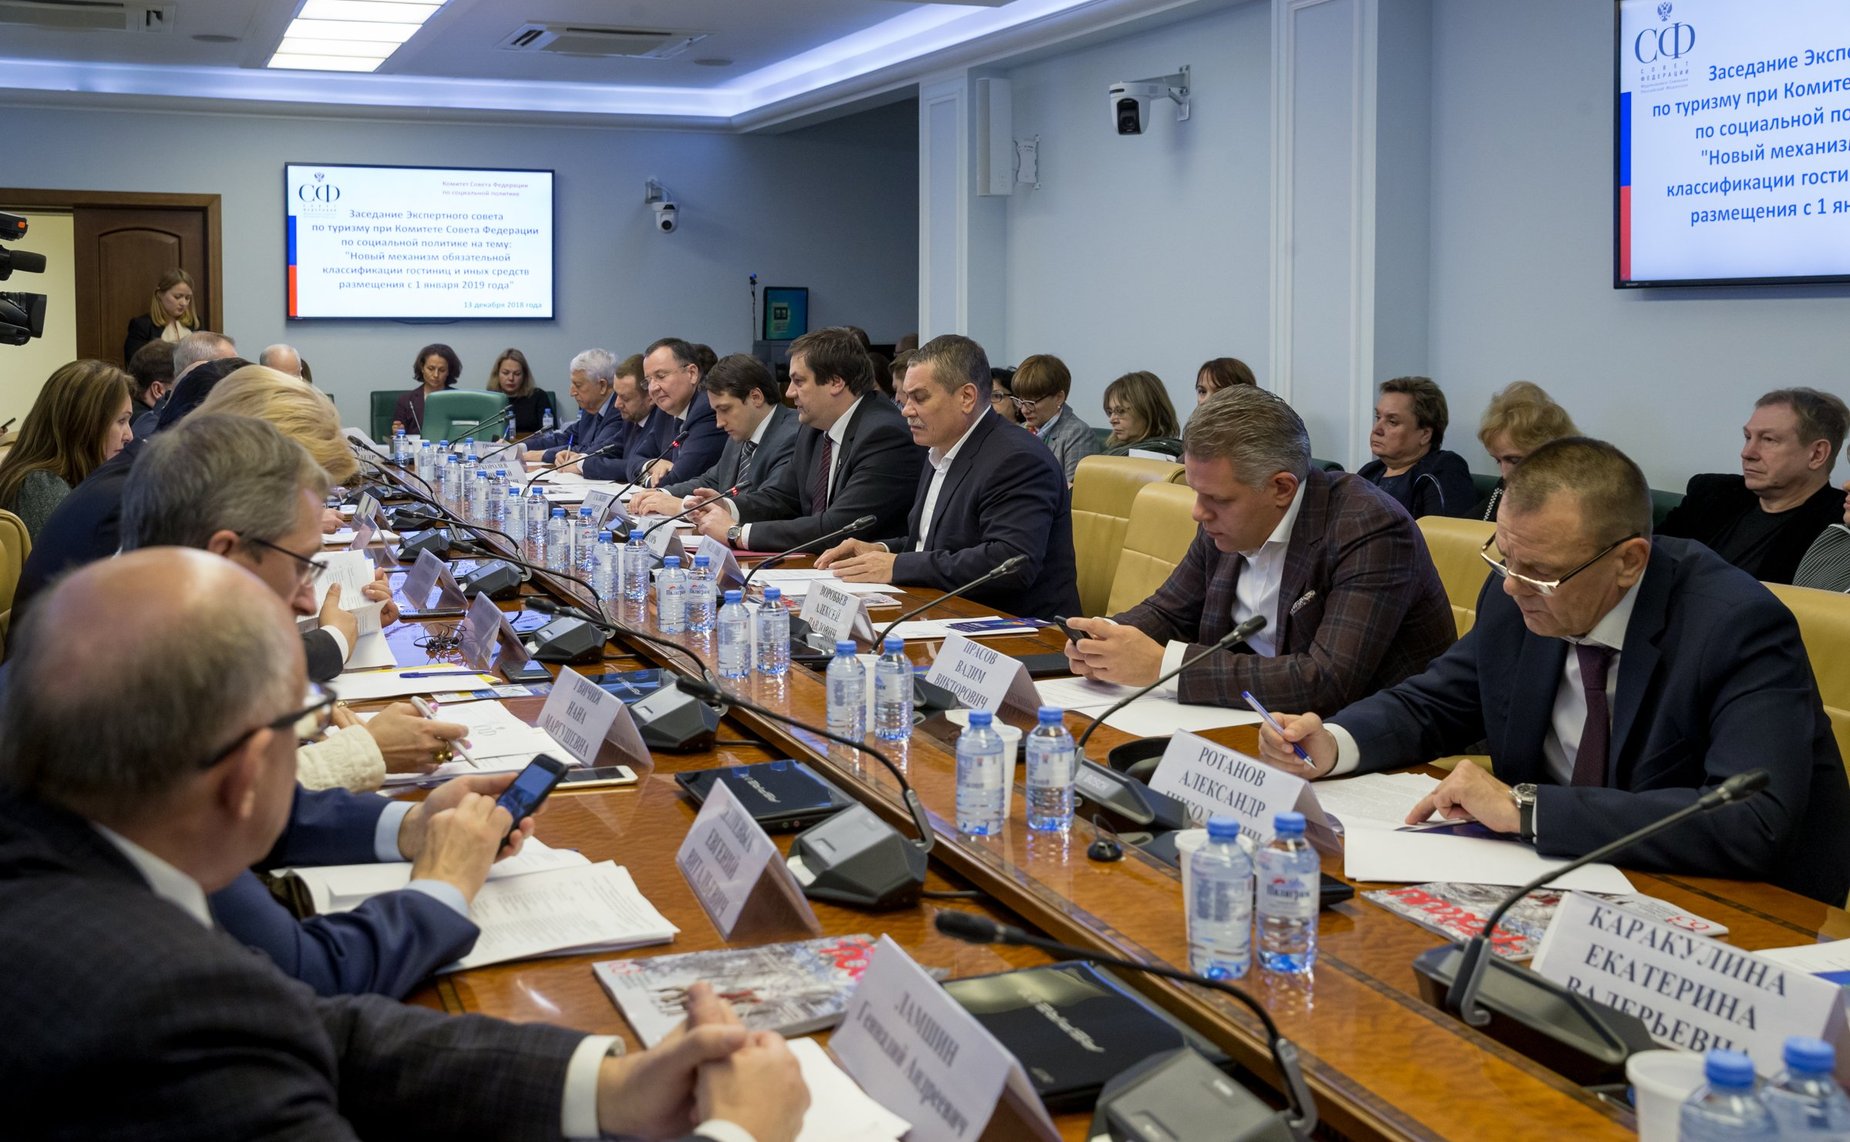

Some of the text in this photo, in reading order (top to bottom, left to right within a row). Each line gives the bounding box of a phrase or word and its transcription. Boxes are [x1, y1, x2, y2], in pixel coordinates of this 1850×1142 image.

[1634, 21, 1696, 64] СФ
[1708, 55, 1799, 82] Заседание
[1652, 103, 1671, 117] по
[1675, 93, 1741, 116] туризму
[1747, 88, 1778, 106] при
[1695, 126, 1715, 139] по
[1720, 106, 1824, 137] социальной
[1701, 138, 1850, 166] "Новый механиз
[299, 184, 341, 203] СФ
[1667, 169, 1849, 197] классификации гости
[350, 209, 404, 219] Заседание
[406, 210, 469, 220] Экспертного
[1691, 201, 1797, 227] размещения
[1803, 203, 1811, 215] с
[1818, 198, 1826, 214] 1
[328, 224, 370, 233] туризму
[373, 225, 392, 234] при
[395, 225, 443, 233] Комитете
[446, 225, 480, 233] Совета
[482, 226, 539, 236] Федерации
[357, 238, 418, 247] социальной
[486, 241, 512, 250] тему:
[345, 251, 511, 262] "Новый механизм обязательной
[322, 266, 403, 276] классификации
[406, 267, 451, 275] гостиниц
[491, 268, 530, 276] средств
[339, 281, 404, 290] размещения
[416, 281, 420, 289] 1
[424, 282, 459, 290] января
[462, 281, 485, 289] 2019
[487, 281, 514, 290] года"
[963, 641, 998, 665] ПРАСОВ
[955, 659, 987, 684] ВАДИМ
[933, 672, 989, 710] ВИКТОРОВИЧ
[566, 701, 588, 725] НАНА
[543, 714, 589, 758] МАРГУШЕВНА
[1198, 746, 1266, 788] РОТАНОВ
[1178, 770, 1266, 819] АЛЕКСАНДР
[1588, 905, 1787, 998] КАРАКУЛИНА
[1583, 944, 1758, 1031] ЕКАТЕРИНА
[1566, 976, 1748, 1056] ВАЛЕРЬЕВН
